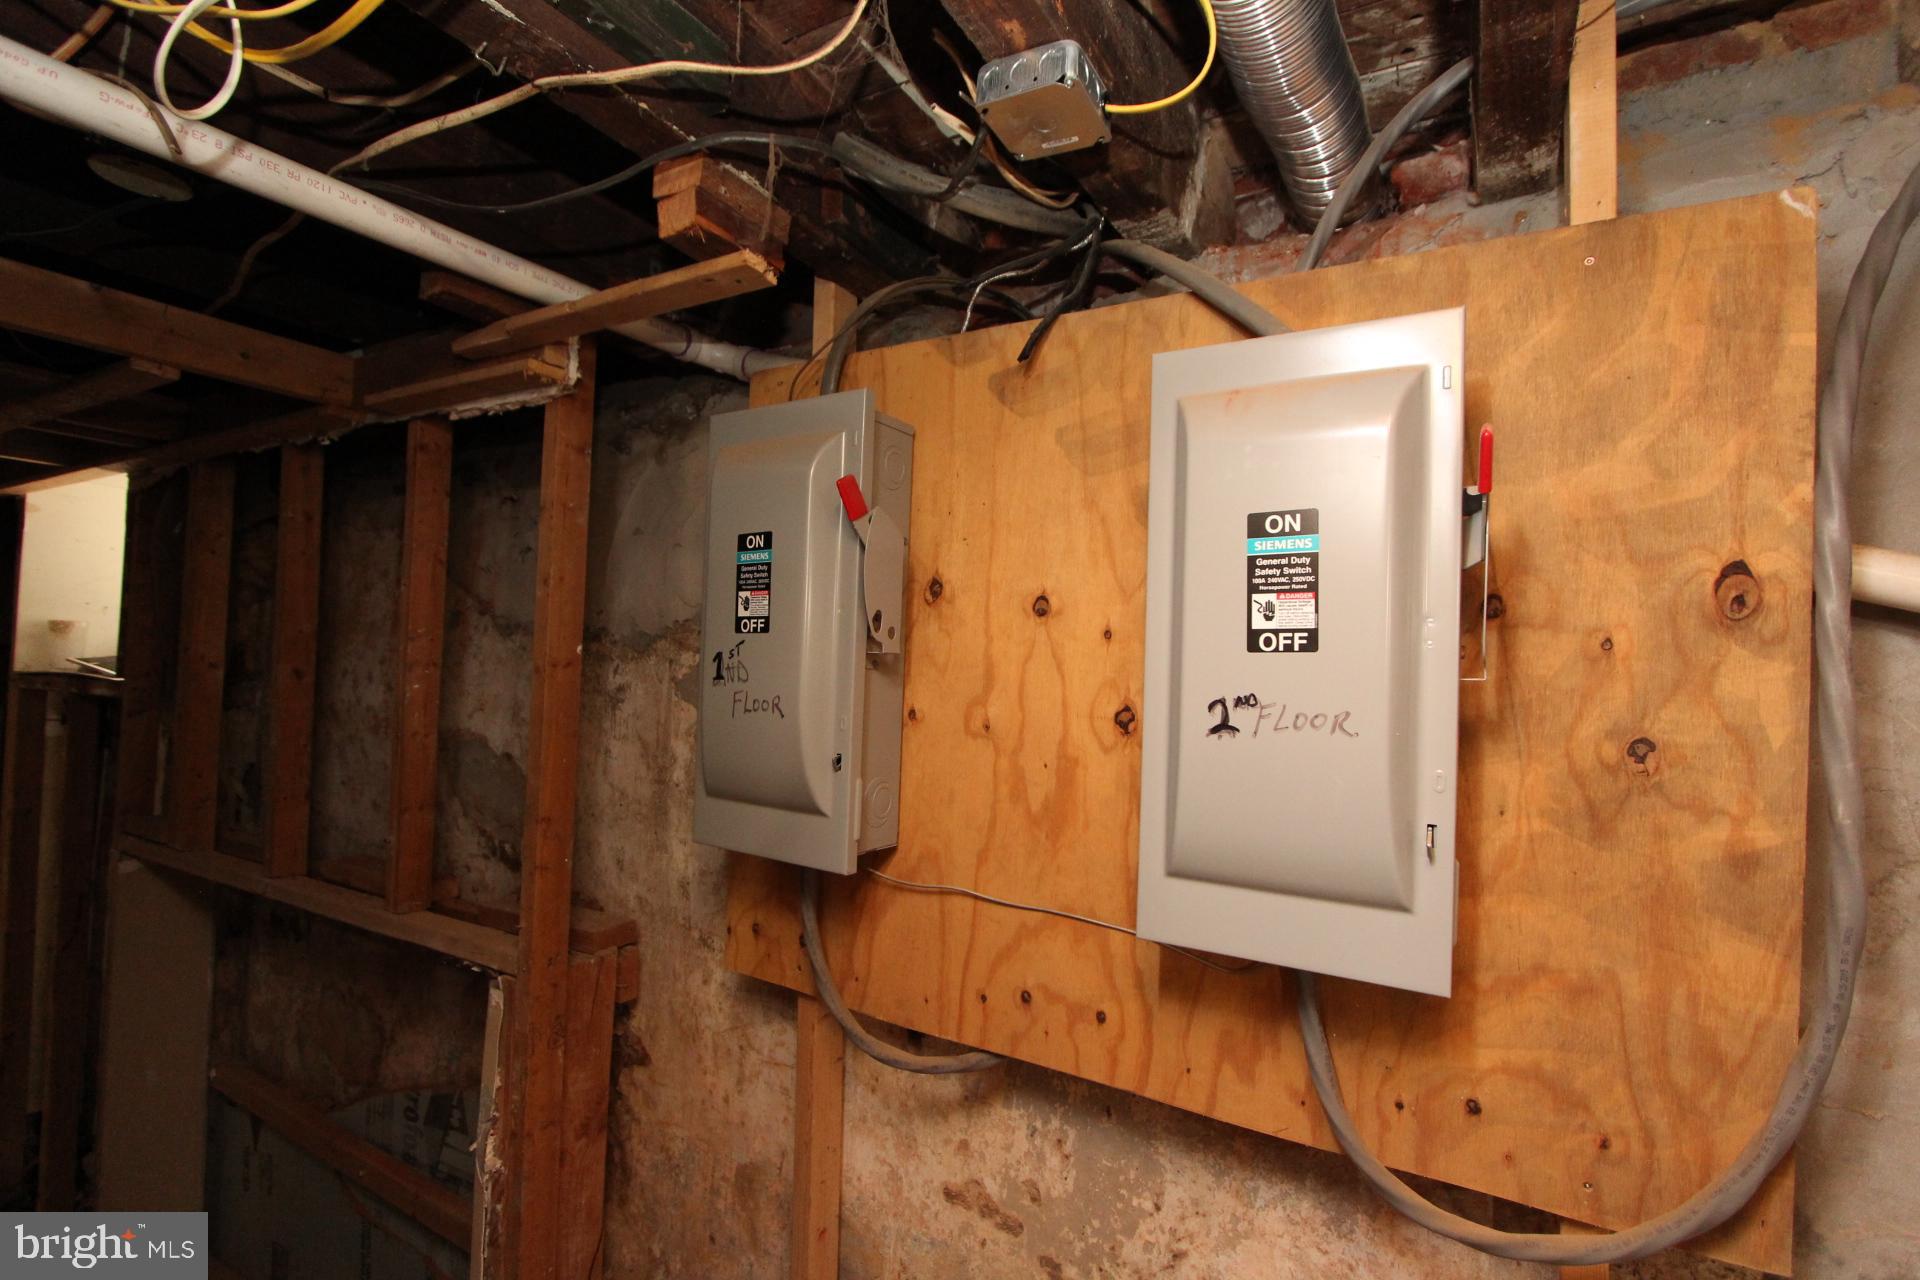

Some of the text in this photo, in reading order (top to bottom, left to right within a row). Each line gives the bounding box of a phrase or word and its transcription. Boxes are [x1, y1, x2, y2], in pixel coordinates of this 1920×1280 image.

[259, 158, 281, 174] 330
[306, 177, 332, 194] 1120
[1265, 513, 1301, 534] ON
[746, 534, 764, 548] ON
[1254, 538, 1313, 551] SIEMENS
[740, 552, 769, 562] SIEMENS
[1256, 556, 1311, 566] General Duty
[1255, 566, 1312, 576] Safety Switch
[741, 619, 765, 633] OFF
[1258, 632, 1308, 652] OFF
[732, 690, 785, 720] FLOOR
